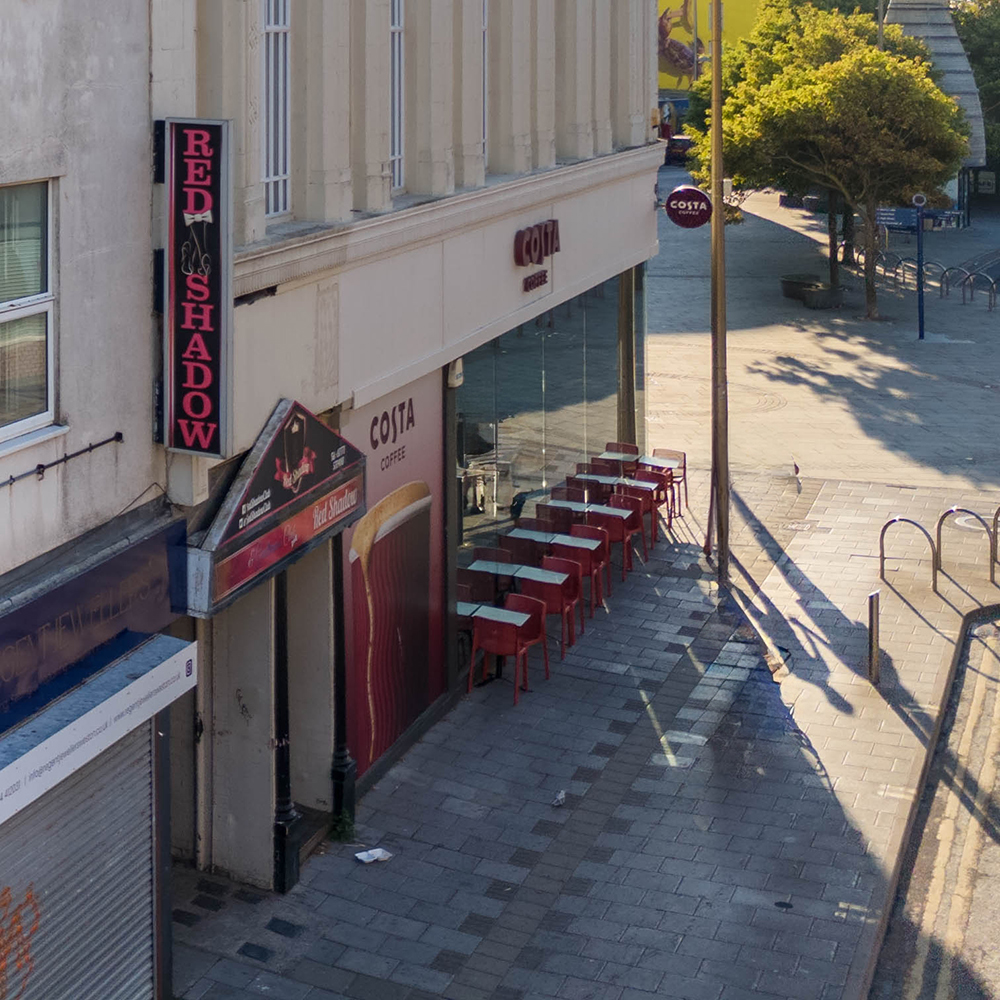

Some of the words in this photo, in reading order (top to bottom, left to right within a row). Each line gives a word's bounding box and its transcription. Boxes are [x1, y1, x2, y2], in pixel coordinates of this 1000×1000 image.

[182, 129, 214, 214] RED
[669, 200, 708, 210] COSTA
[177, 273, 217, 449] SHADOW
[369, 398, 415, 450] COSTA
[380, 445, 406, 471] COFFEE
[312, 505, 327, 530] Red
[328, 487, 359, 520] Shadow
